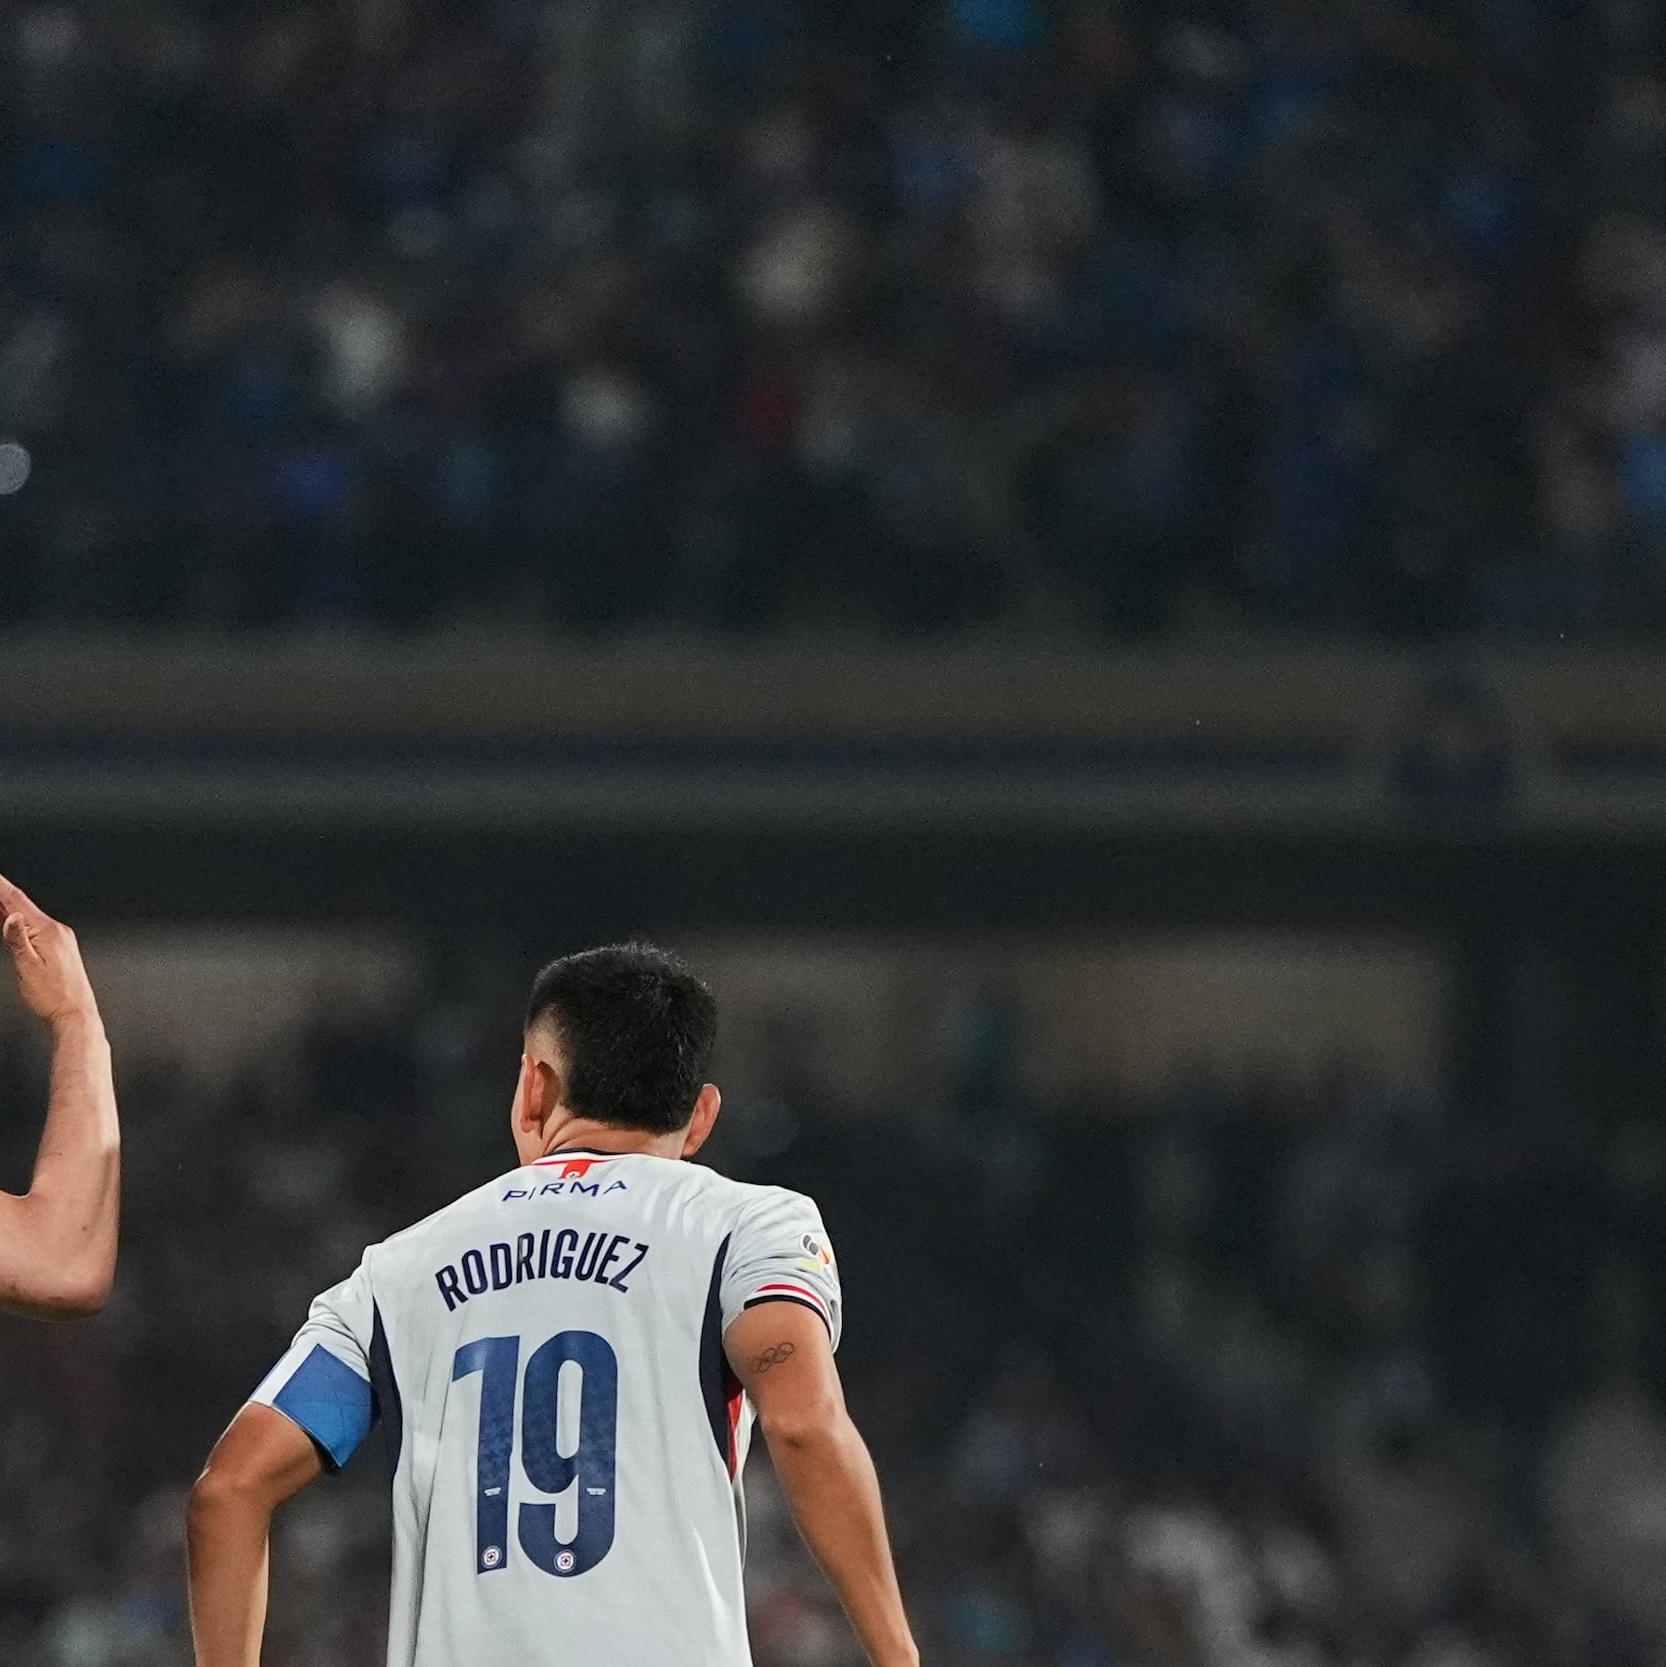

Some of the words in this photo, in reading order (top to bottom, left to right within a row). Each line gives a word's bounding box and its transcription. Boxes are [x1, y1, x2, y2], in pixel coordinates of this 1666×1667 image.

[501, 1179, 628, 1202] PIRMA
[434, 1228, 650, 1313] RODRIGUEZ
[451, 1330, 619, 1578] 19
